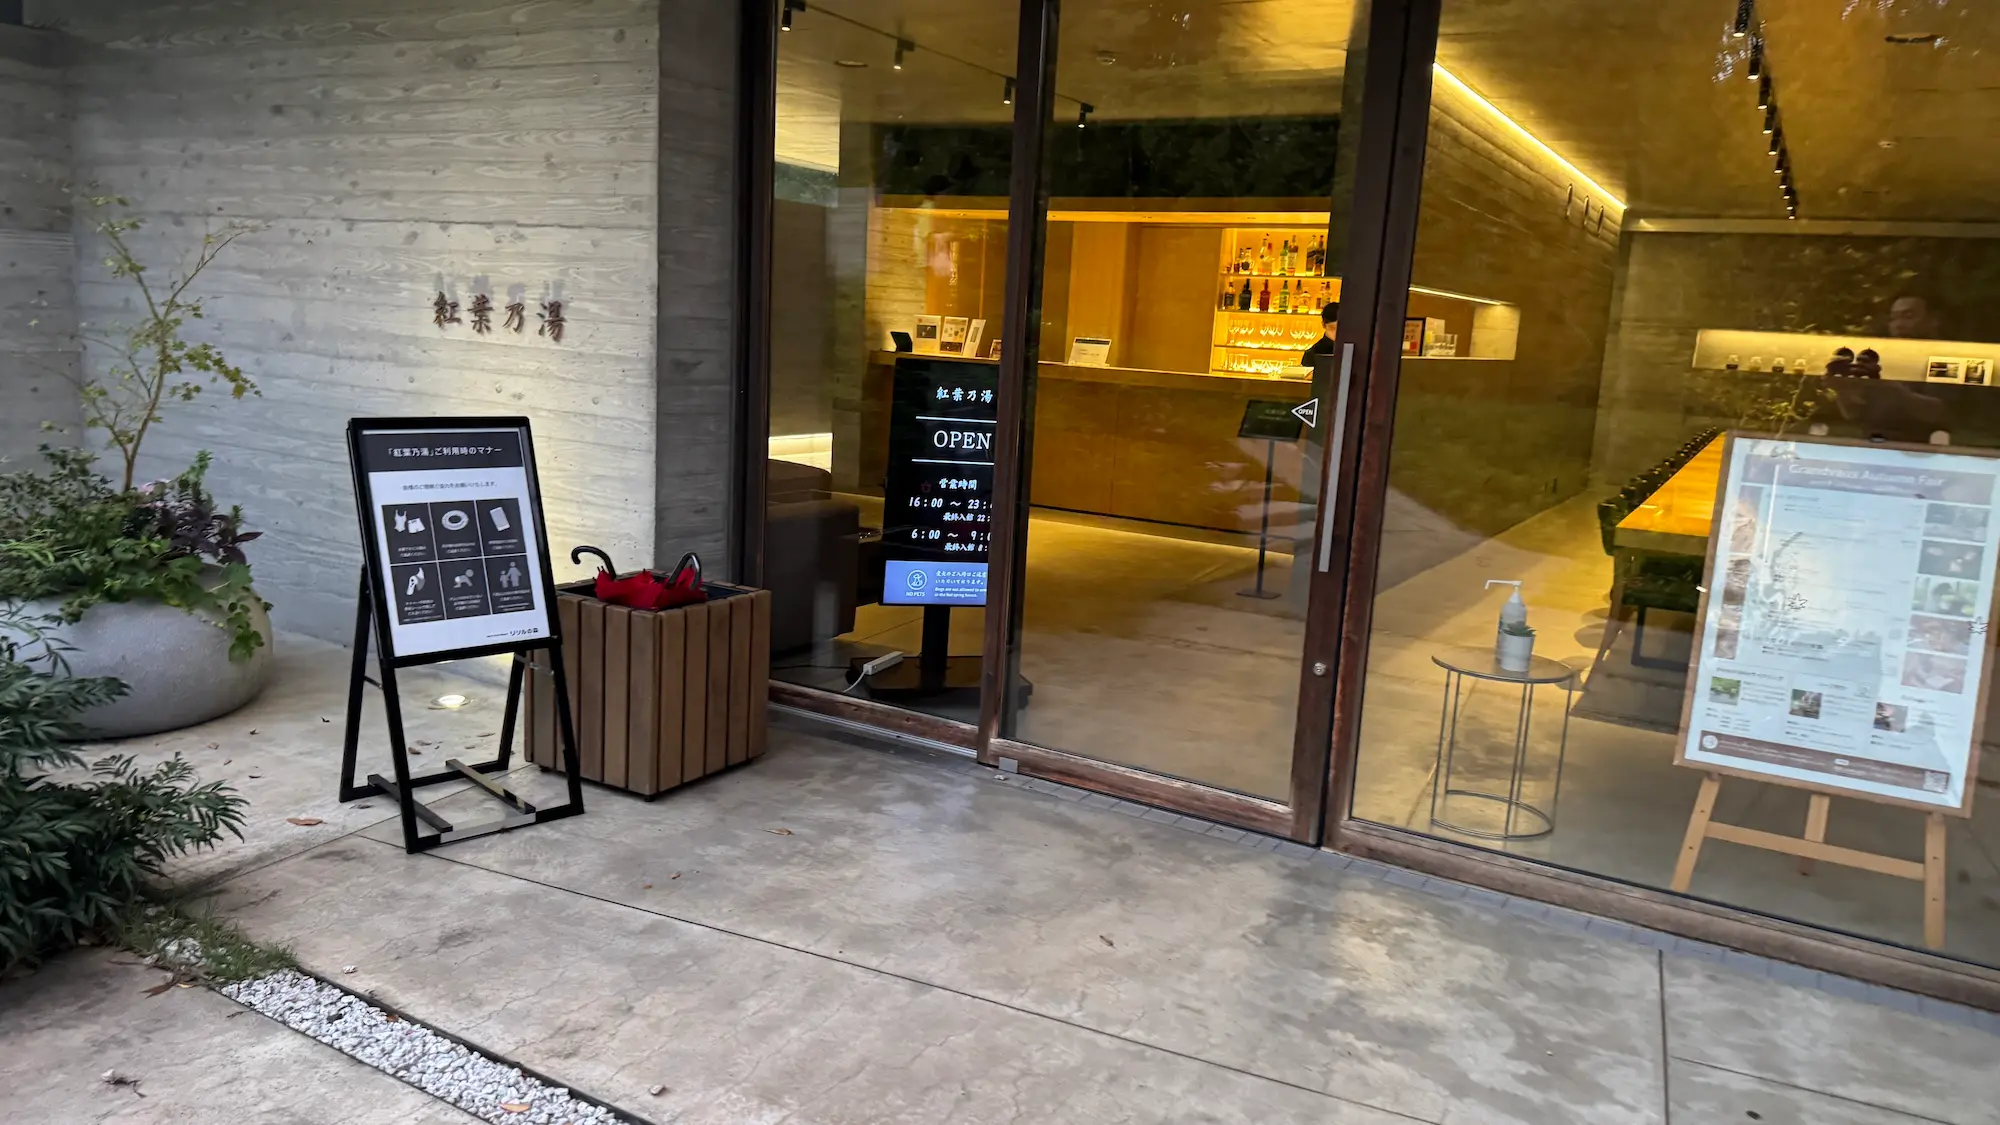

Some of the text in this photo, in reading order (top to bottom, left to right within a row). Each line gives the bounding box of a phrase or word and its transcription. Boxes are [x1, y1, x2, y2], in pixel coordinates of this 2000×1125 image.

[433, 291, 567, 342] 紅葉乃湯
[936, 386, 993, 404] 紅葉乃湯
[1298, 408, 1313, 416] OPEN
[933, 430, 992, 450] OPEN
[388, 446, 502, 457] 「紅葉乃湯」ご利用時のマナー
[939, 478, 977, 490] 営業時間
[909, 497, 943, 508] 16:00
[943, 512, 974, 521] 最終入館
[911, 528, 941, 539] 6:00
[944, 542, 975, 551] 最終入館
